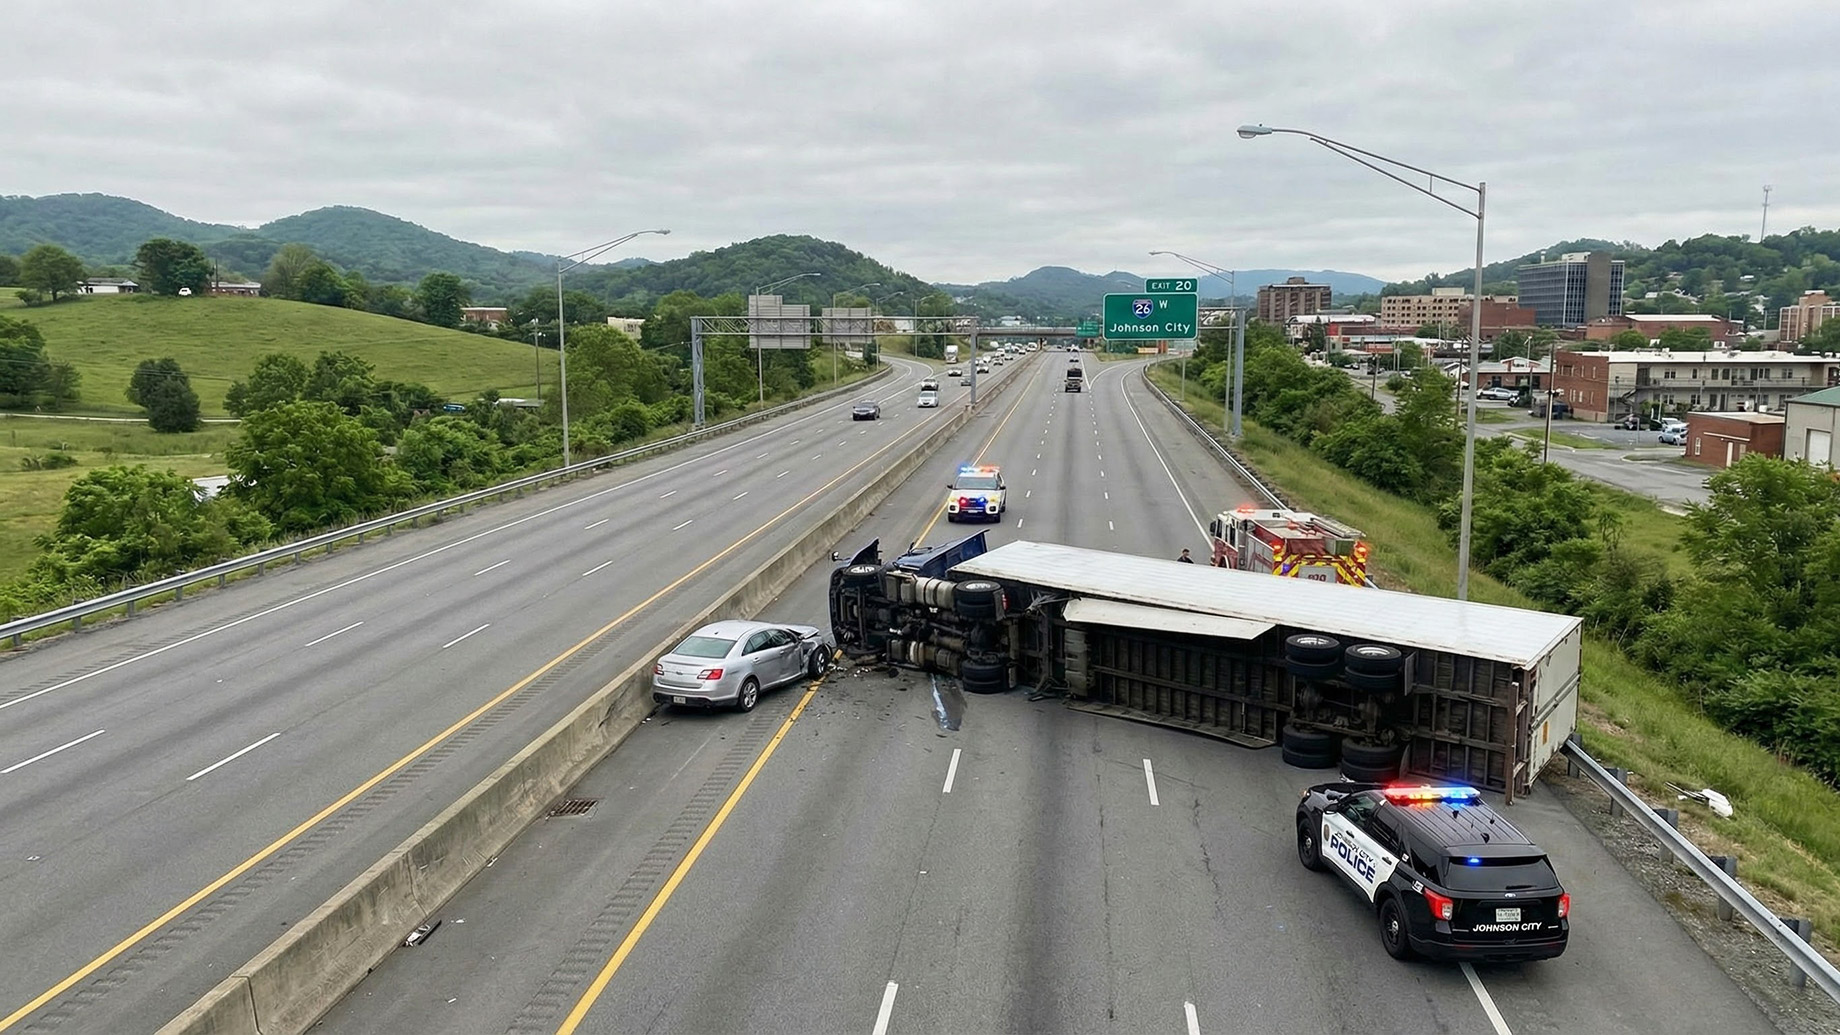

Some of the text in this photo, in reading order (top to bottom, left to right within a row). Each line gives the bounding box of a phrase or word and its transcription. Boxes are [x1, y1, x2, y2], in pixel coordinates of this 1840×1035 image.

[1175, 280, 1192, 291] 20
[1135, 300, 1168, 314] 26 W
[1109, 323, 1159, 332] Johnson
[1165, 322, 1190, 334] City
[1330, 834, 1376, 884] POLICE
[1472, 922, 1543, 932] JOHNSON CITY
